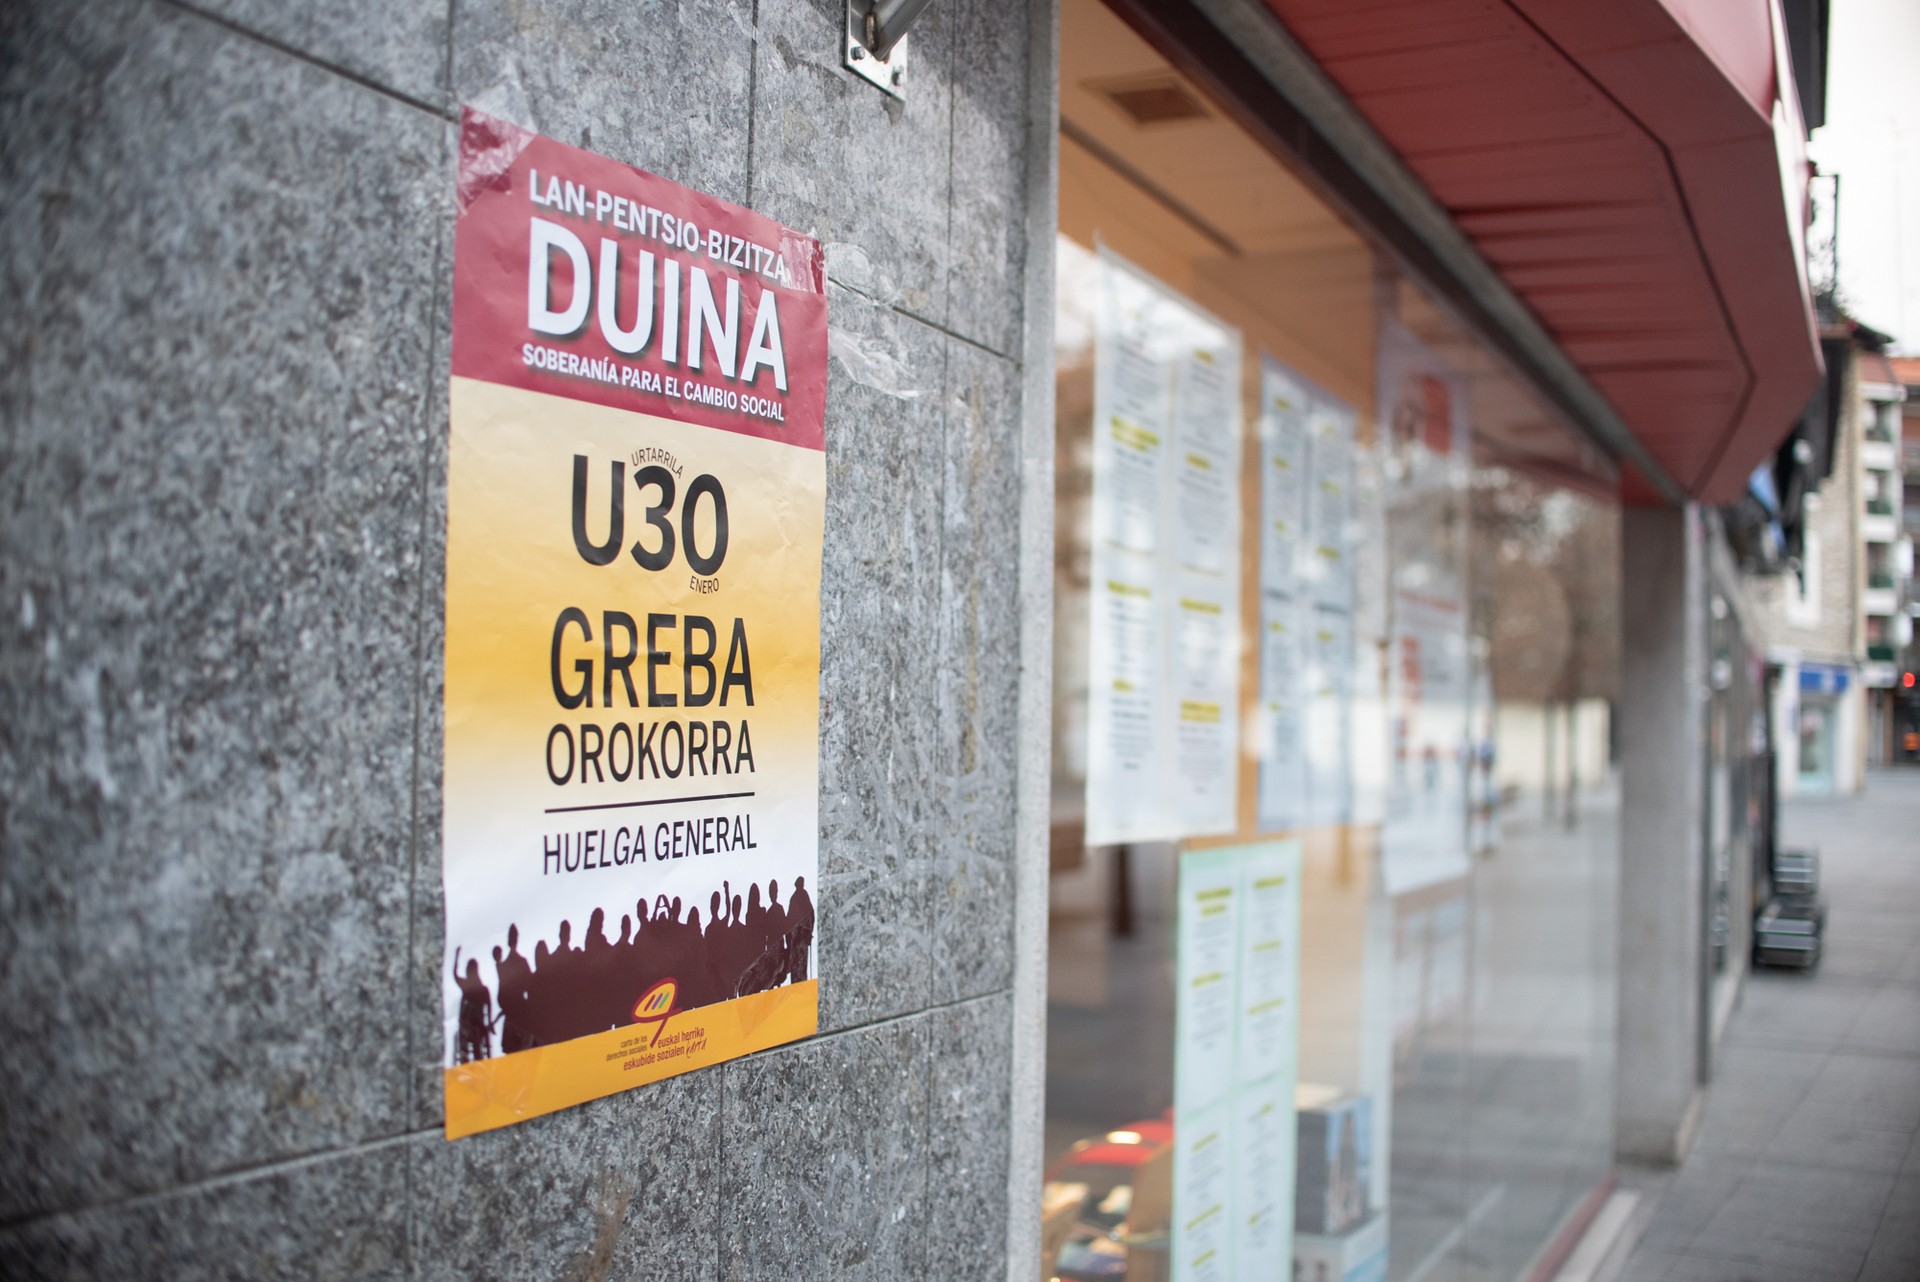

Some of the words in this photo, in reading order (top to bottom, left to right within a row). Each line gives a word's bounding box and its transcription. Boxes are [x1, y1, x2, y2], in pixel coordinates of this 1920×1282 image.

[529, 168, 787, 284] LAN-PENTSIO-BIZITZA
[528, 217, 788, 391] DUINA
[522, 343, 619, 384] SOBERANÍA
[622, 366, 662, 394] PARA
[665, 376, 681, 398] EL
[683, 380, 737, 410] CAMBIO
[740, 393, 785, 422] SOCIAL
[631, 447, 683, 479] URTARRILA
[572, 454, 729, 576] U30
[689, 575, 720, 594] ENERO
[551, 606, 755, 710] GREBA
[546, 719, 756, 786] OROKORRA
[543, 825, 647, 875] HUELGA
[654, 814, 758, 861] GENERAL
[623, 1053, 655, 1071] eskubide
[656, 1045, 685, 1062] sozialen
[657, 1032, 681, 1048] euskal
[681, 1027, 705, 1041] herriko
